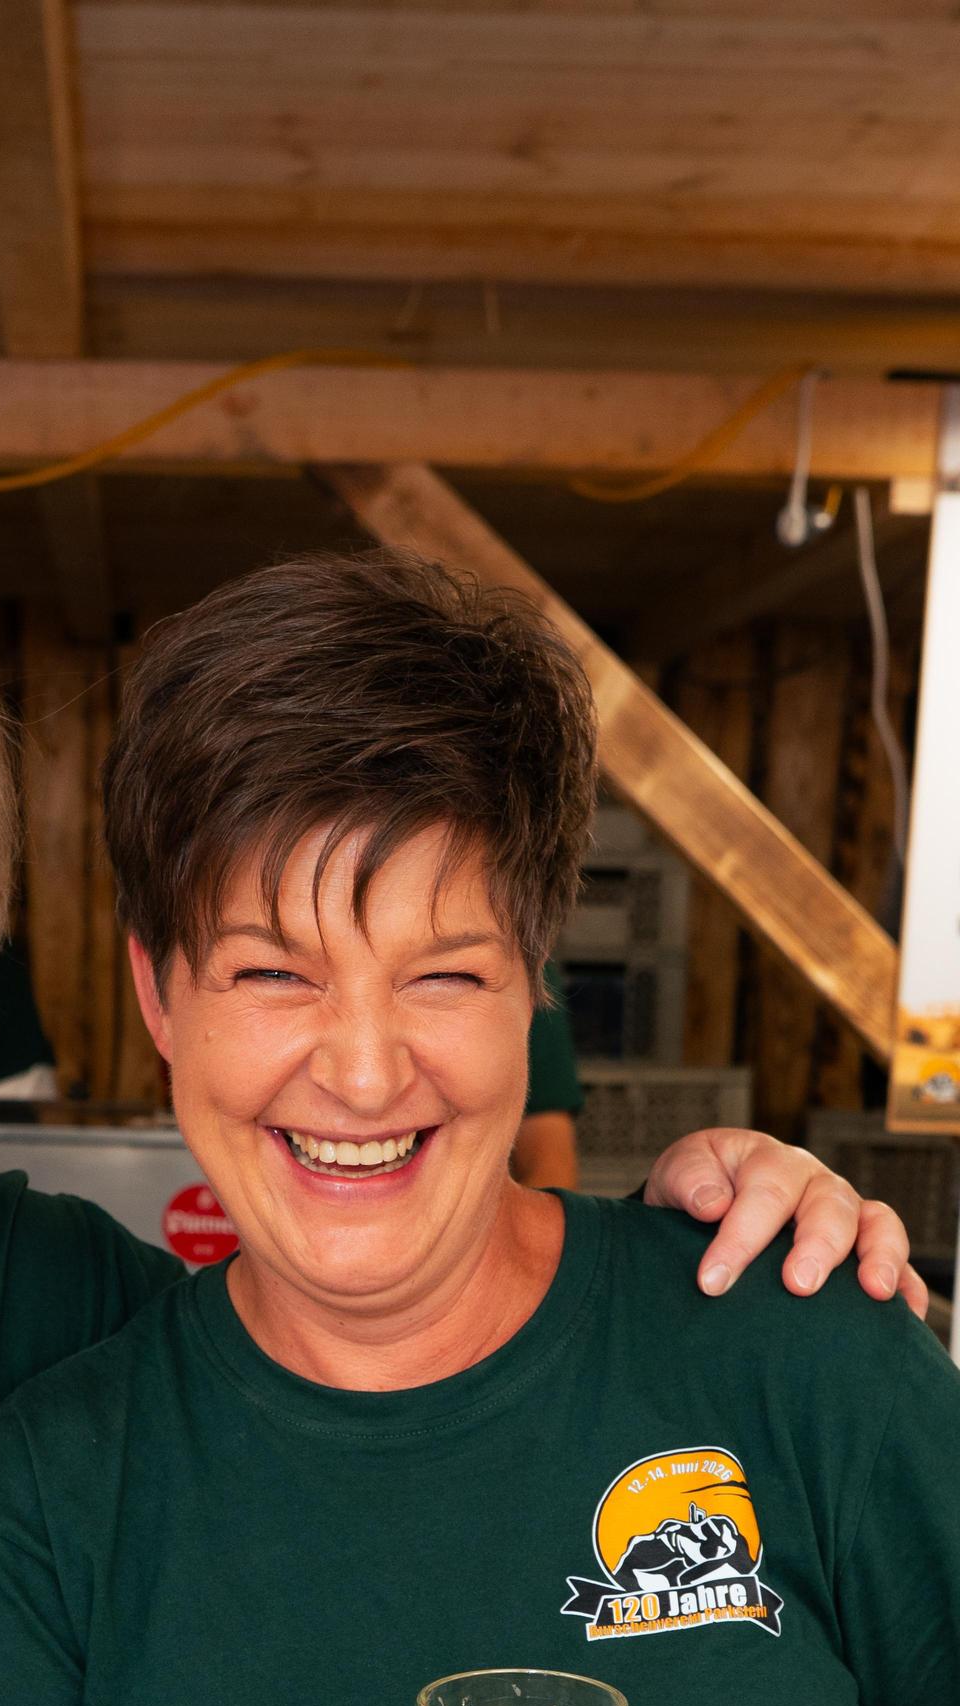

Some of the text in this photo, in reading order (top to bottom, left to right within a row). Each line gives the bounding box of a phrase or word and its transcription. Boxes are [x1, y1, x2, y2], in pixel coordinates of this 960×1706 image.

[627, 1459, 734, 1494] 12.-14. Juni 2026
[607, 1582, 748, 1624] 120 Jahre
